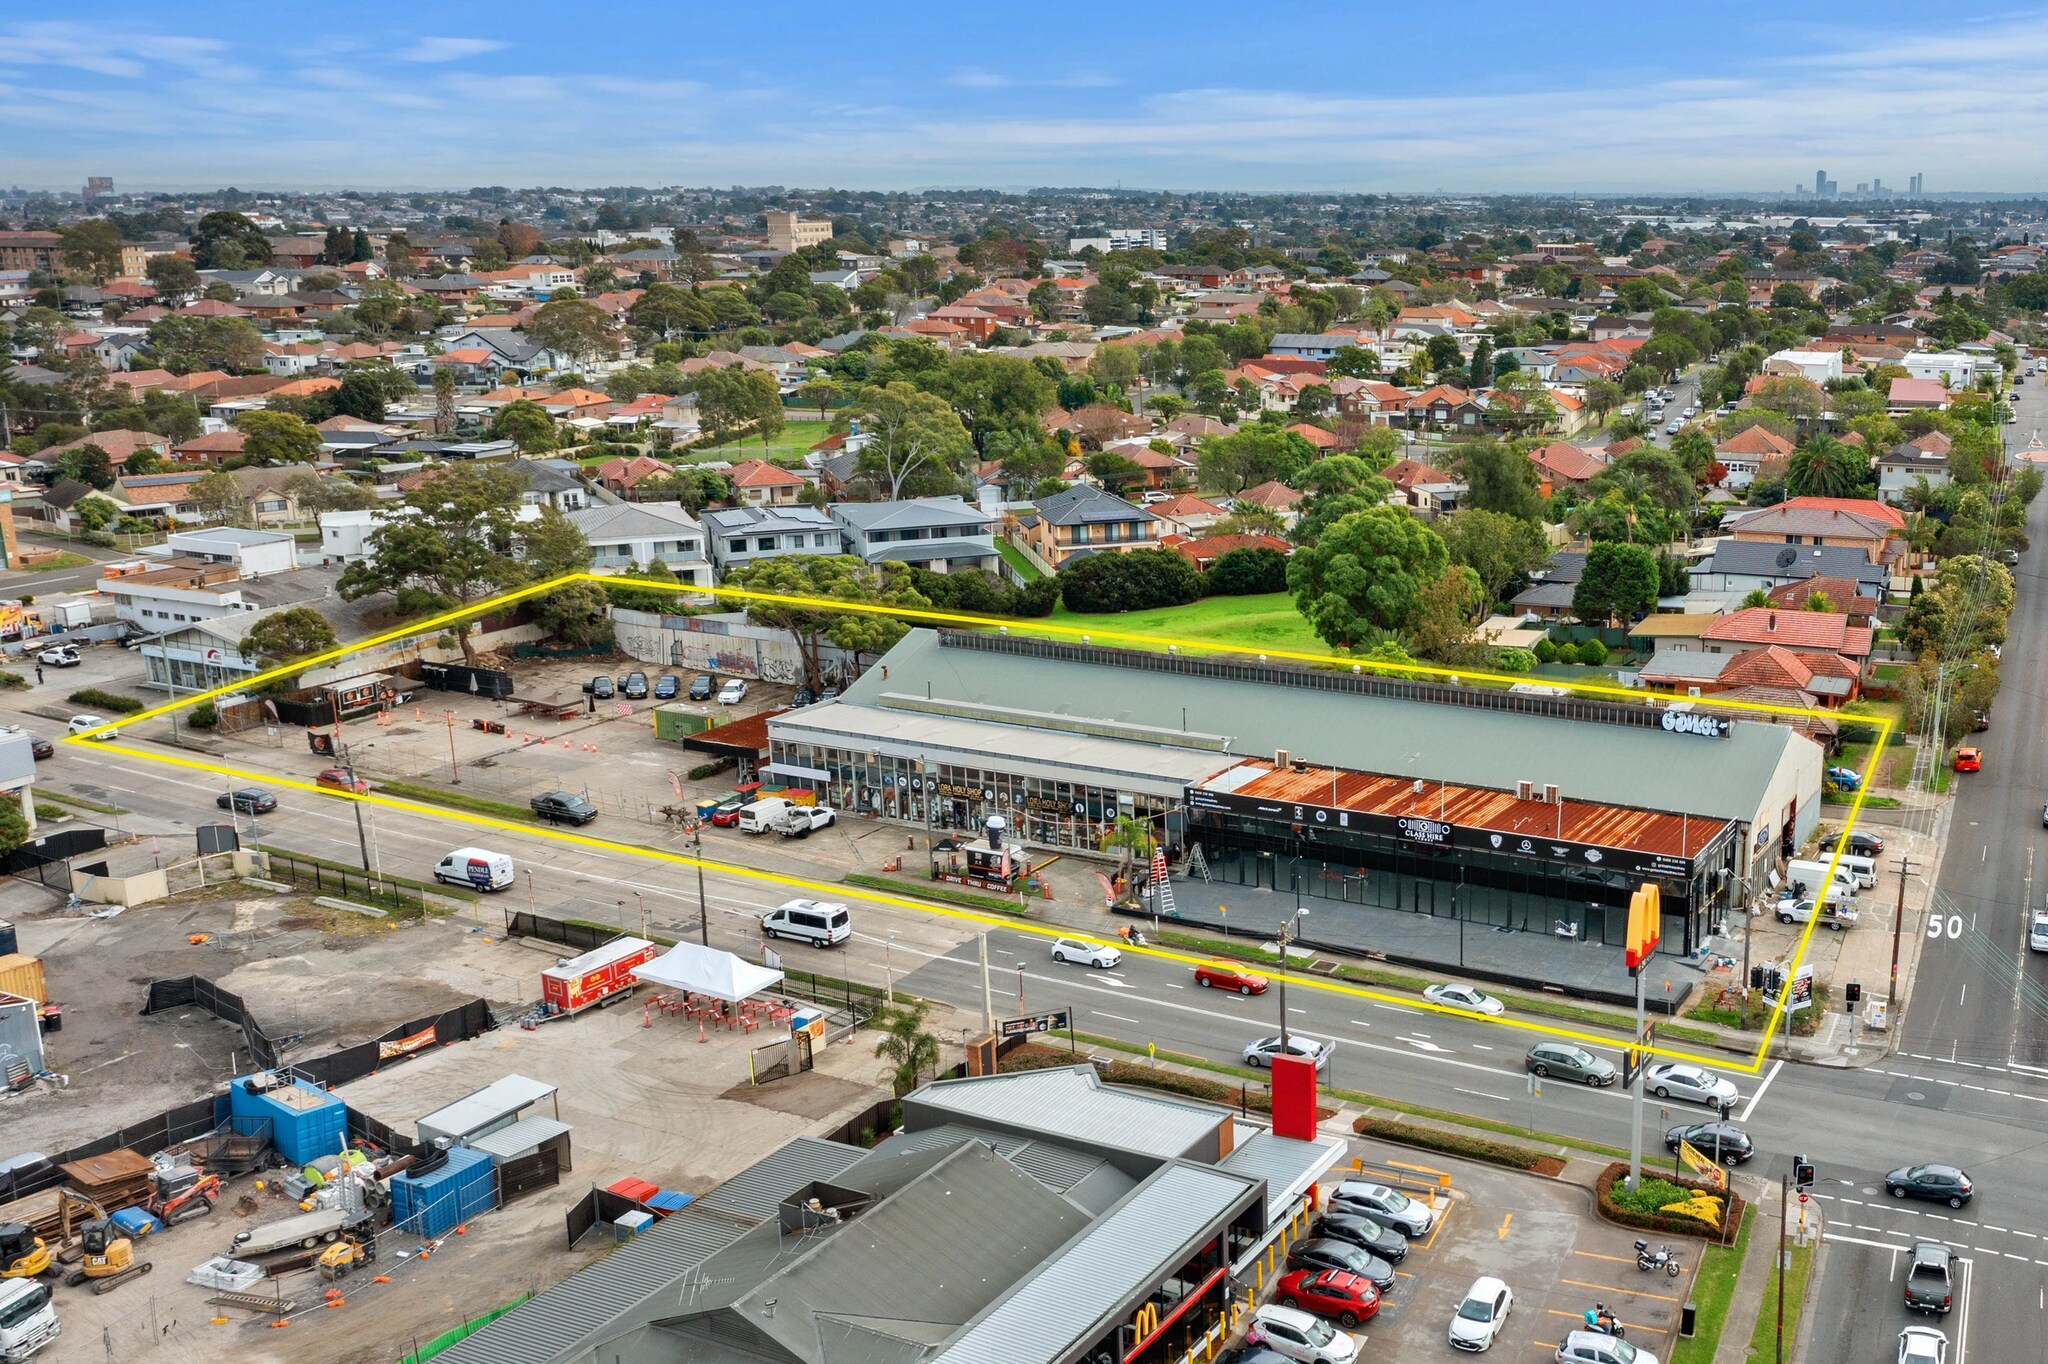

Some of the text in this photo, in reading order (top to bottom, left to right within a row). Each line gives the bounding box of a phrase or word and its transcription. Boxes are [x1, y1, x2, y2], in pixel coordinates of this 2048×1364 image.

[953, 785, 967, 795] HOLY
[967, 787, 982, 797] SHOP
[1042, 800, 1057, 808] HOLY
[1405, 830, 1444, 842] CLASS HIRE
[468, 865, 489, 873] PENDLE
[946, 875, 962, 884] DRIVE
[967, 879, 982, 887] THRU
[987, 883, 1007, 893] COFFEE
[1927, 914, 1962, 939] 50
[92, 1257, 107, 1266] CAT
